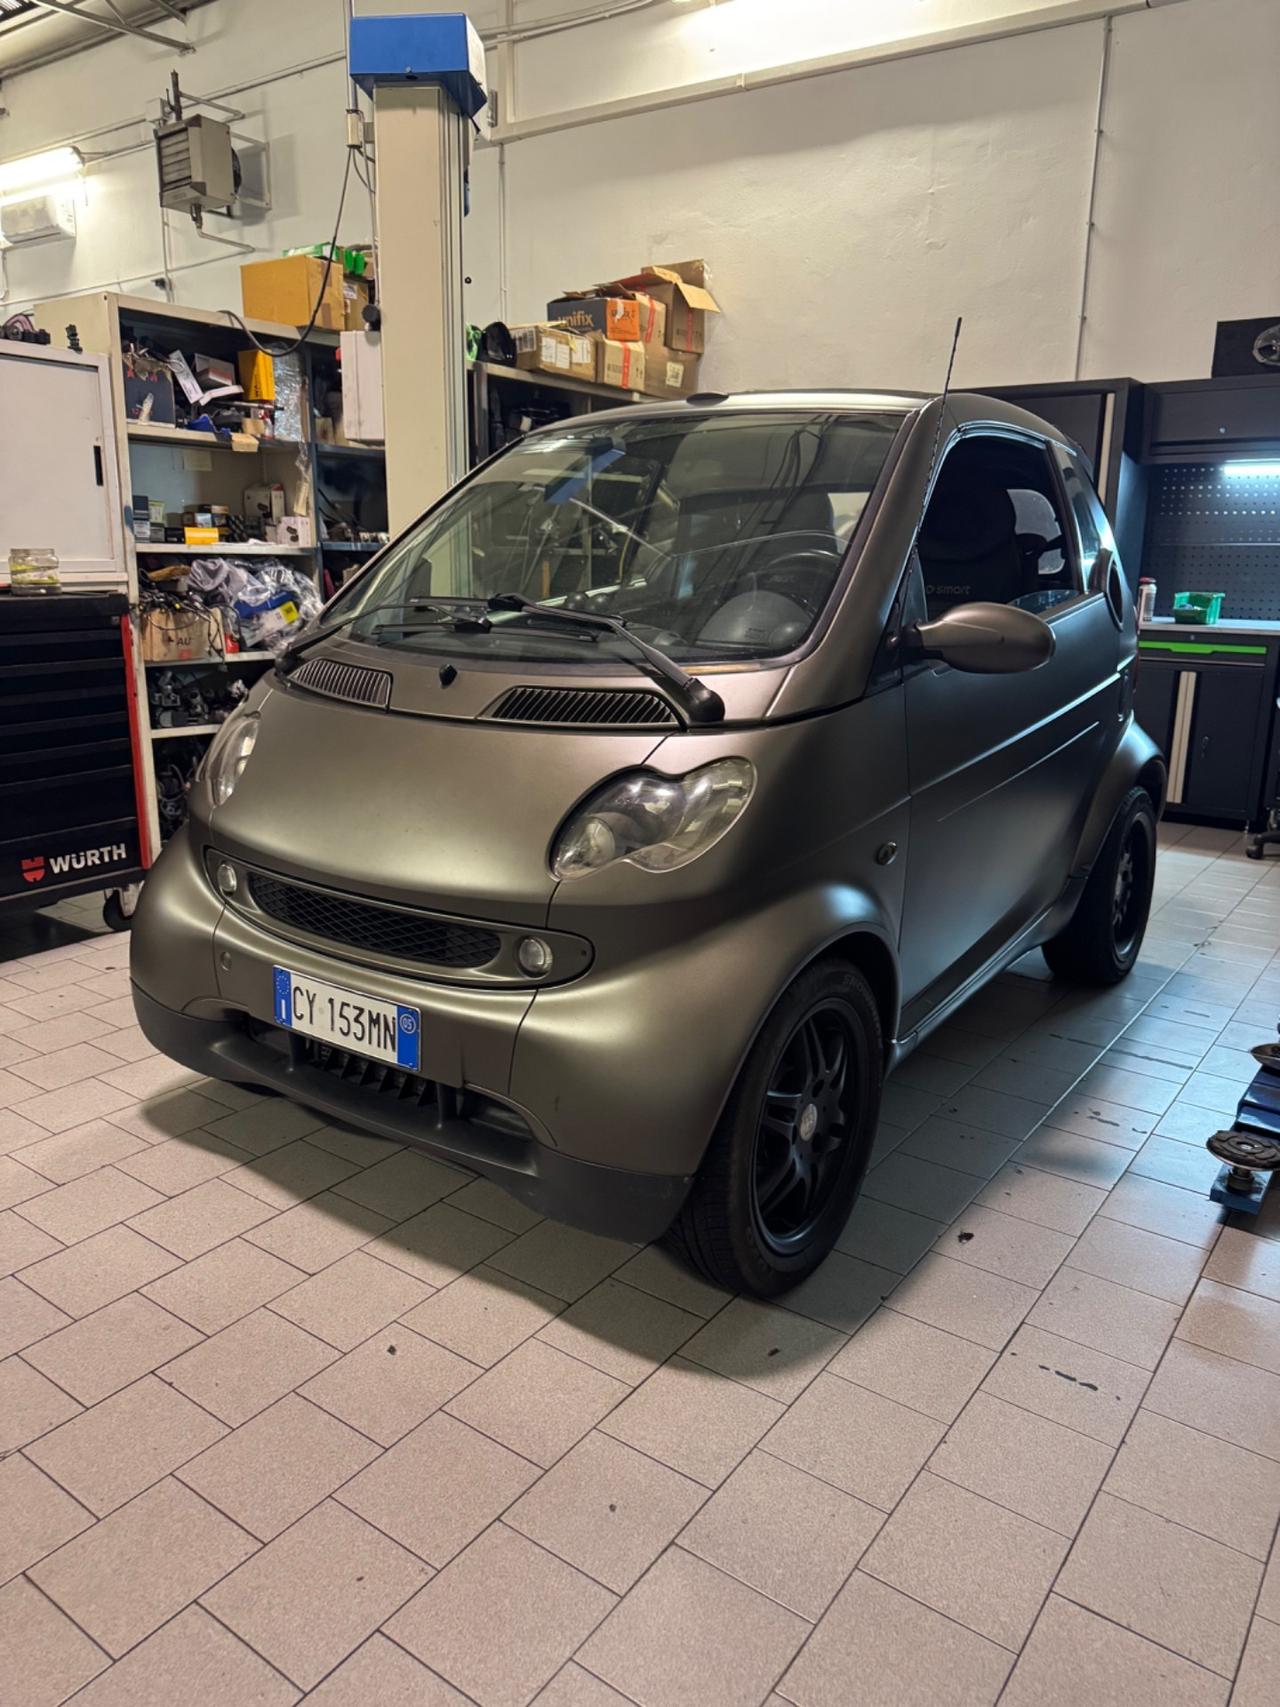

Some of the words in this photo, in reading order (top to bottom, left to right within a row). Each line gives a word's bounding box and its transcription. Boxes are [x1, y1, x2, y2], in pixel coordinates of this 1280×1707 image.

[936, 584, 971, 595] smart
[49, 843, 127, 875] WÜRTH
[293, 985, 317, 1026] CY
[328, 997, 396, 1053] 153MN
